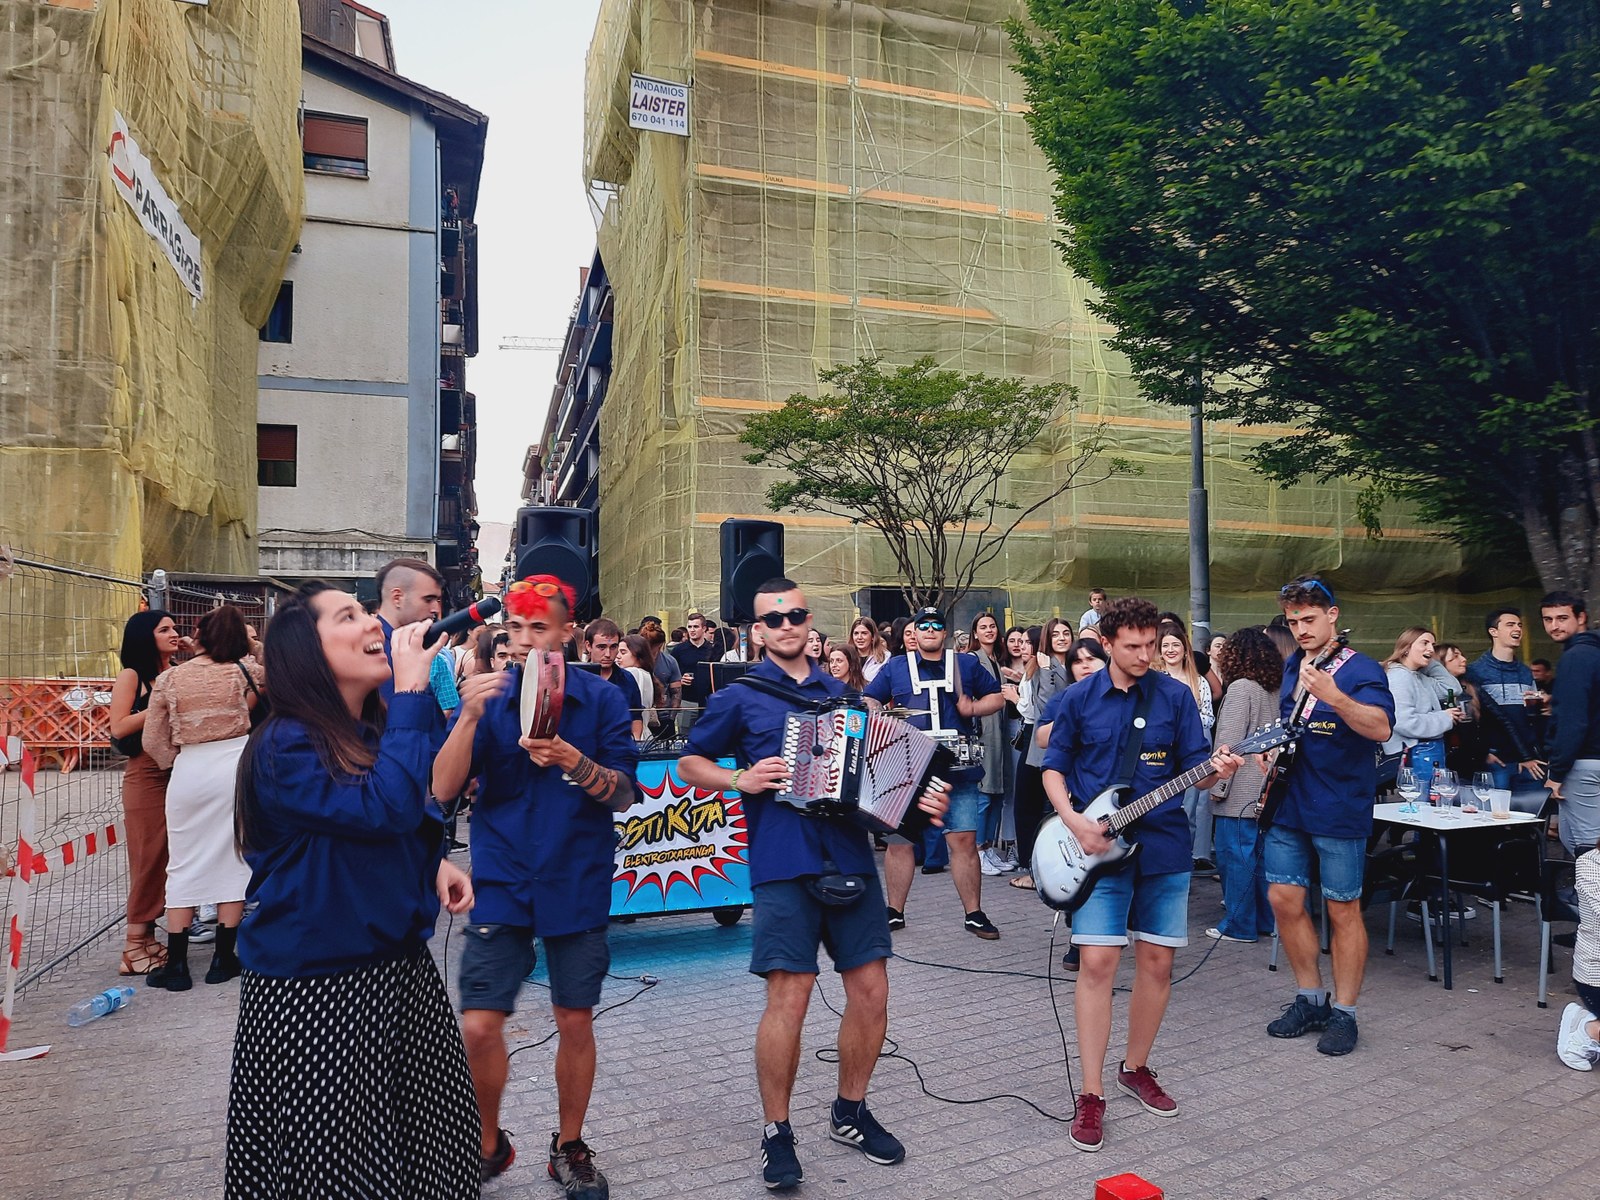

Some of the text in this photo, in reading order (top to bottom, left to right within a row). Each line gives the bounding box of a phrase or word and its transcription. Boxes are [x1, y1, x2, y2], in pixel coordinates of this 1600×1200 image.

[634, 80, 684, 97] ANDAMIOS
[632, 92, 685, 117] LAISTER
[631, 112, 685, 128] 670 041 114
[623, 844, 716, 868] ELEKTROTXARANGA
